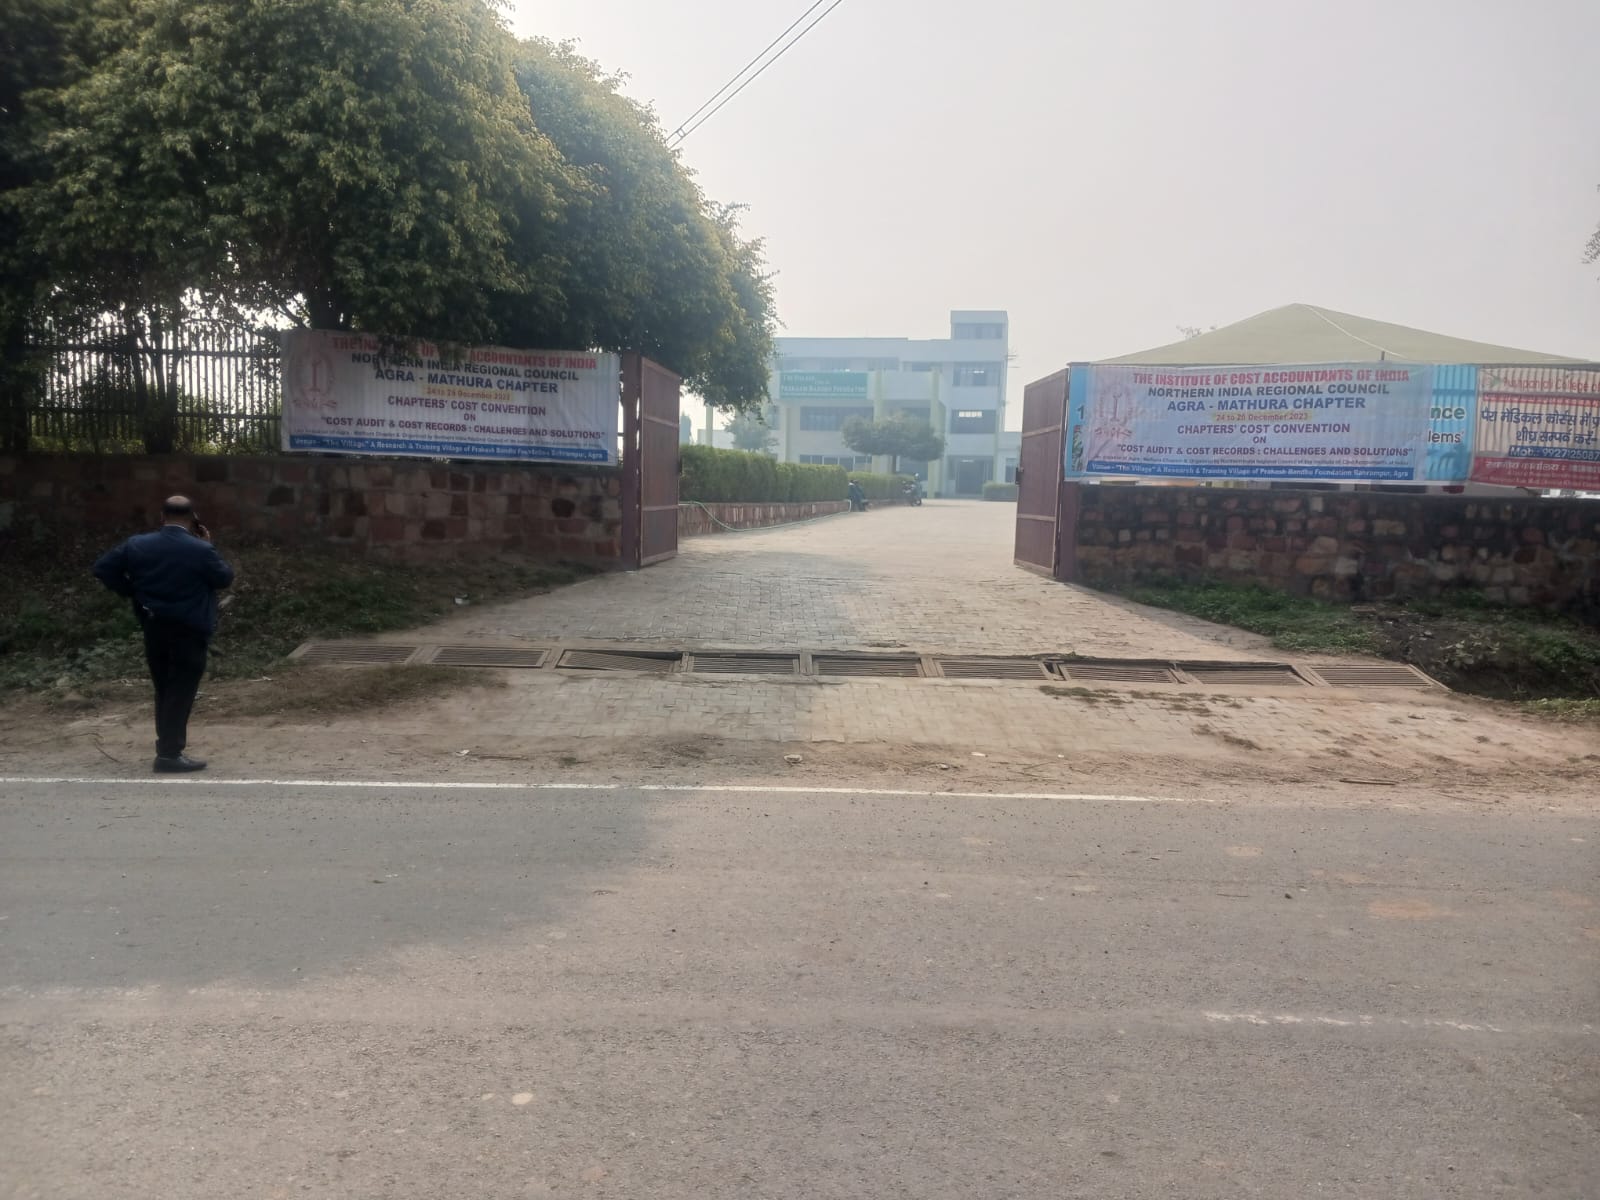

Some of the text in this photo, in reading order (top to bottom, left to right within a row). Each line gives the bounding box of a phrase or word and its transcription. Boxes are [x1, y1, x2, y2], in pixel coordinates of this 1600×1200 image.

[470, 350, 547, 368] ACCOUNTANTS
[549, 357, 561, 367] OF
[564, 358, 597, 369] INDIA
[464, 364, 521, 378] REGIONAL
[524, 369, 579, 381] COUNCIL
[1133, 370, 1409, 386] THE INSTITUTE OF COST ACCOUNTANTS OF INDIA
[376, 369, 415, 382] AGRA
[427, 374, 492, 389] MATHURA
[497, 379, 558, 393] CHAPTER
[1148, 383, 1390, 398] NORTHERN INDIA REGIONAL COUNCIL
[388, 396, 546, 416] CHAPTERS' COST CONVENTION
[1167, 401, 1205, 411] AGRA
[1217, 399, 1288, 411] MATHURA
[1293, 397, 1366, 409] CHAPTER
[464, 413, 476, 421] ON
[1248, 413, 1287, 421] December
[1430, 407, 1465, 419] nce
[321, 416, 352, 426] "COST
[356, 418, 386, 427] AUDIT
[399, 420, 422, 429] COST
[425, 422, 467, 432] RECORDS
[474, 425, 527, 436] CHALLENGES
[529, 427, 547, 436] AND
[550, 429, 605, 440] SOLUTIONS"
[1177, 423, 1350, 434] CHAPTERS' COST CONVENTION
[1253, 436, 1266, 444] ON
[1117, 444, 1143, 452] "COST
[1146, 446, 1172, 454] AUDIT
[1186, 447, 1210, 455] COST
[1212, 447, 1255, 455] RECORDS
[1263, 447, 1326, 456] CHALLENGES
[1330, 447, 1350, 456] AND
[1353, 448, 1413, 457] SOLUTIONS"
